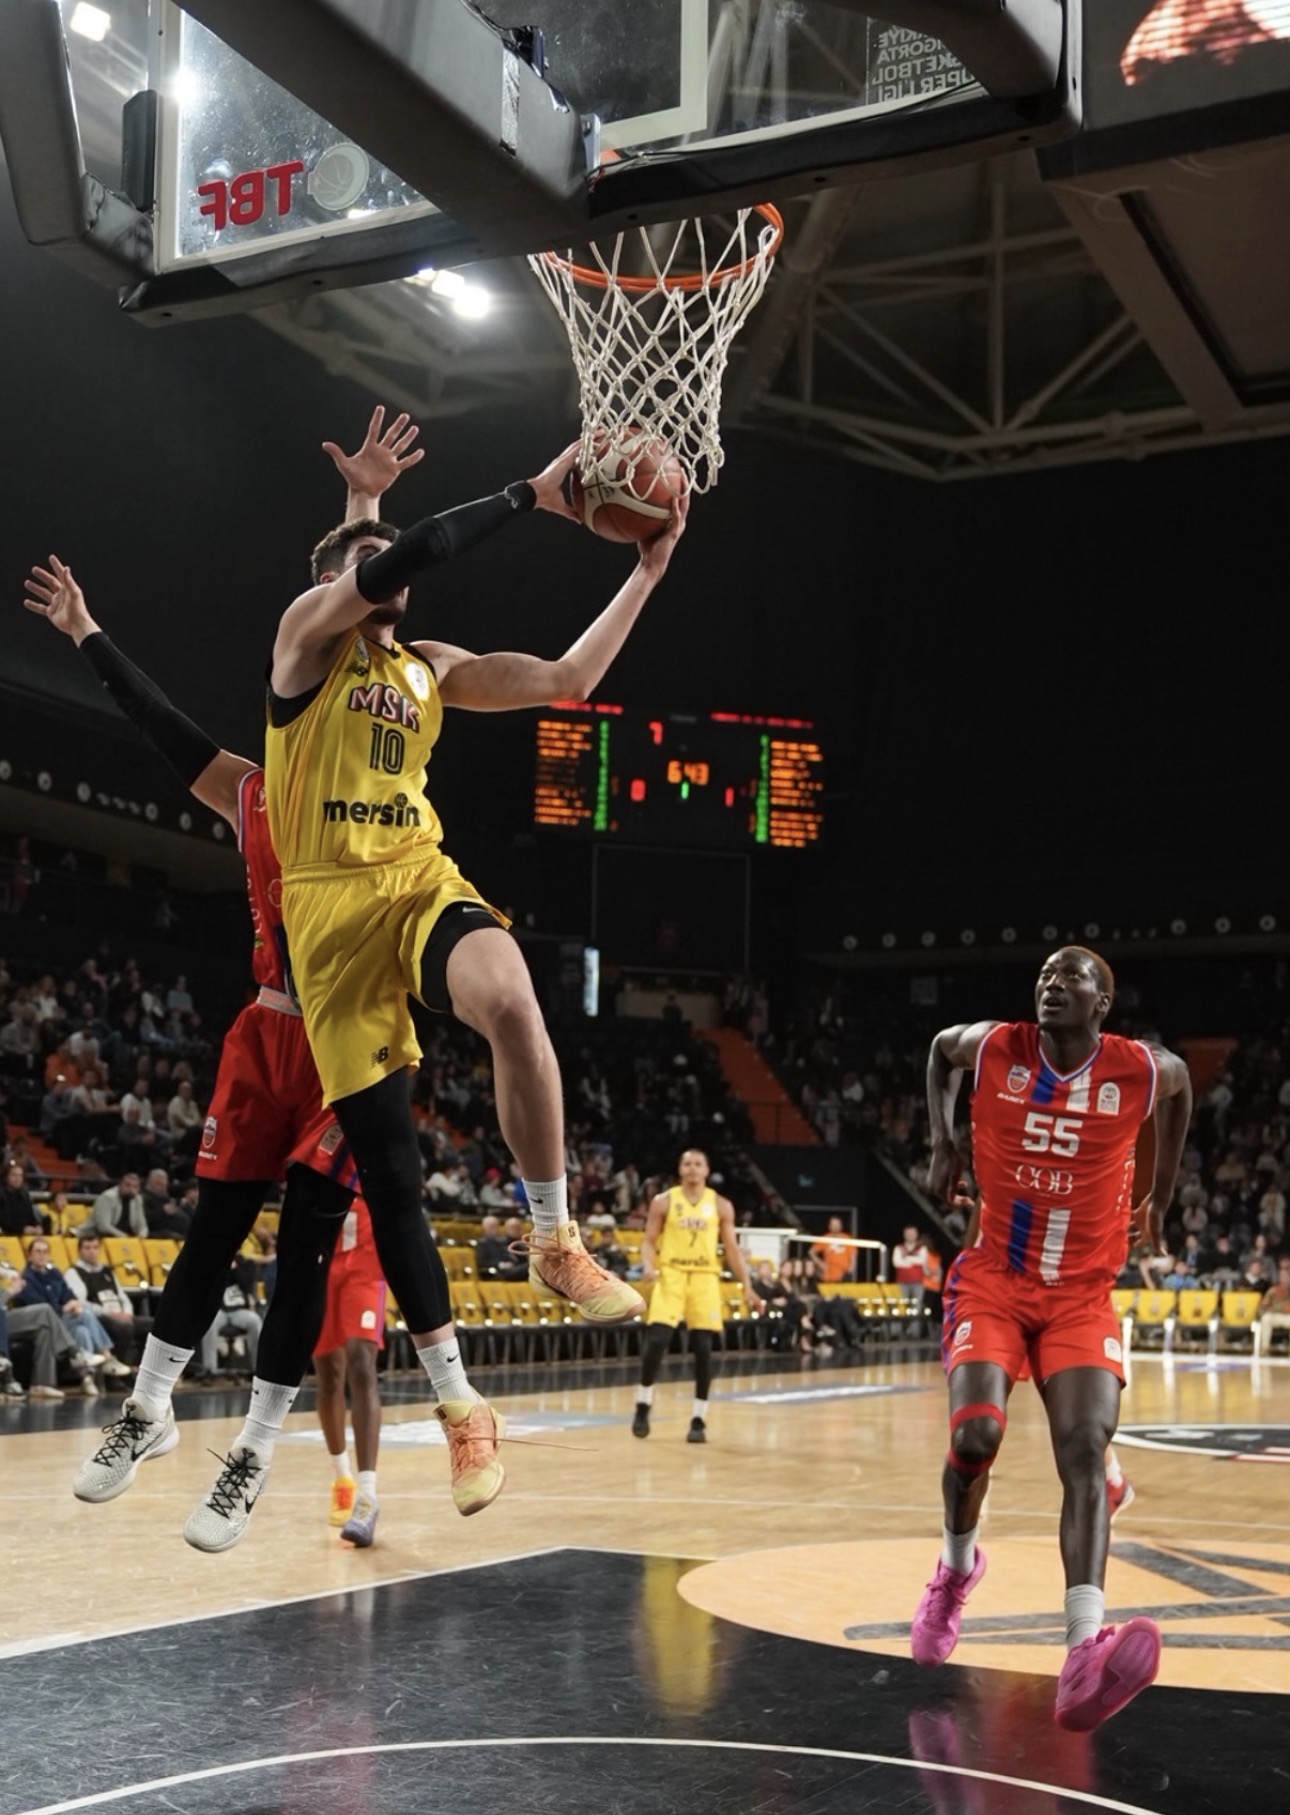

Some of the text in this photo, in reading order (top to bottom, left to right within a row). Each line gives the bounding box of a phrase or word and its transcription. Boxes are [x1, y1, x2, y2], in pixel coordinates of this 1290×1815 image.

[348, 682, 421, 734] MSK
[369, 722, 406, 776] 10
[323, 792, 421, 828] mersin
[1021, 1111, 1084, 1158] 55
